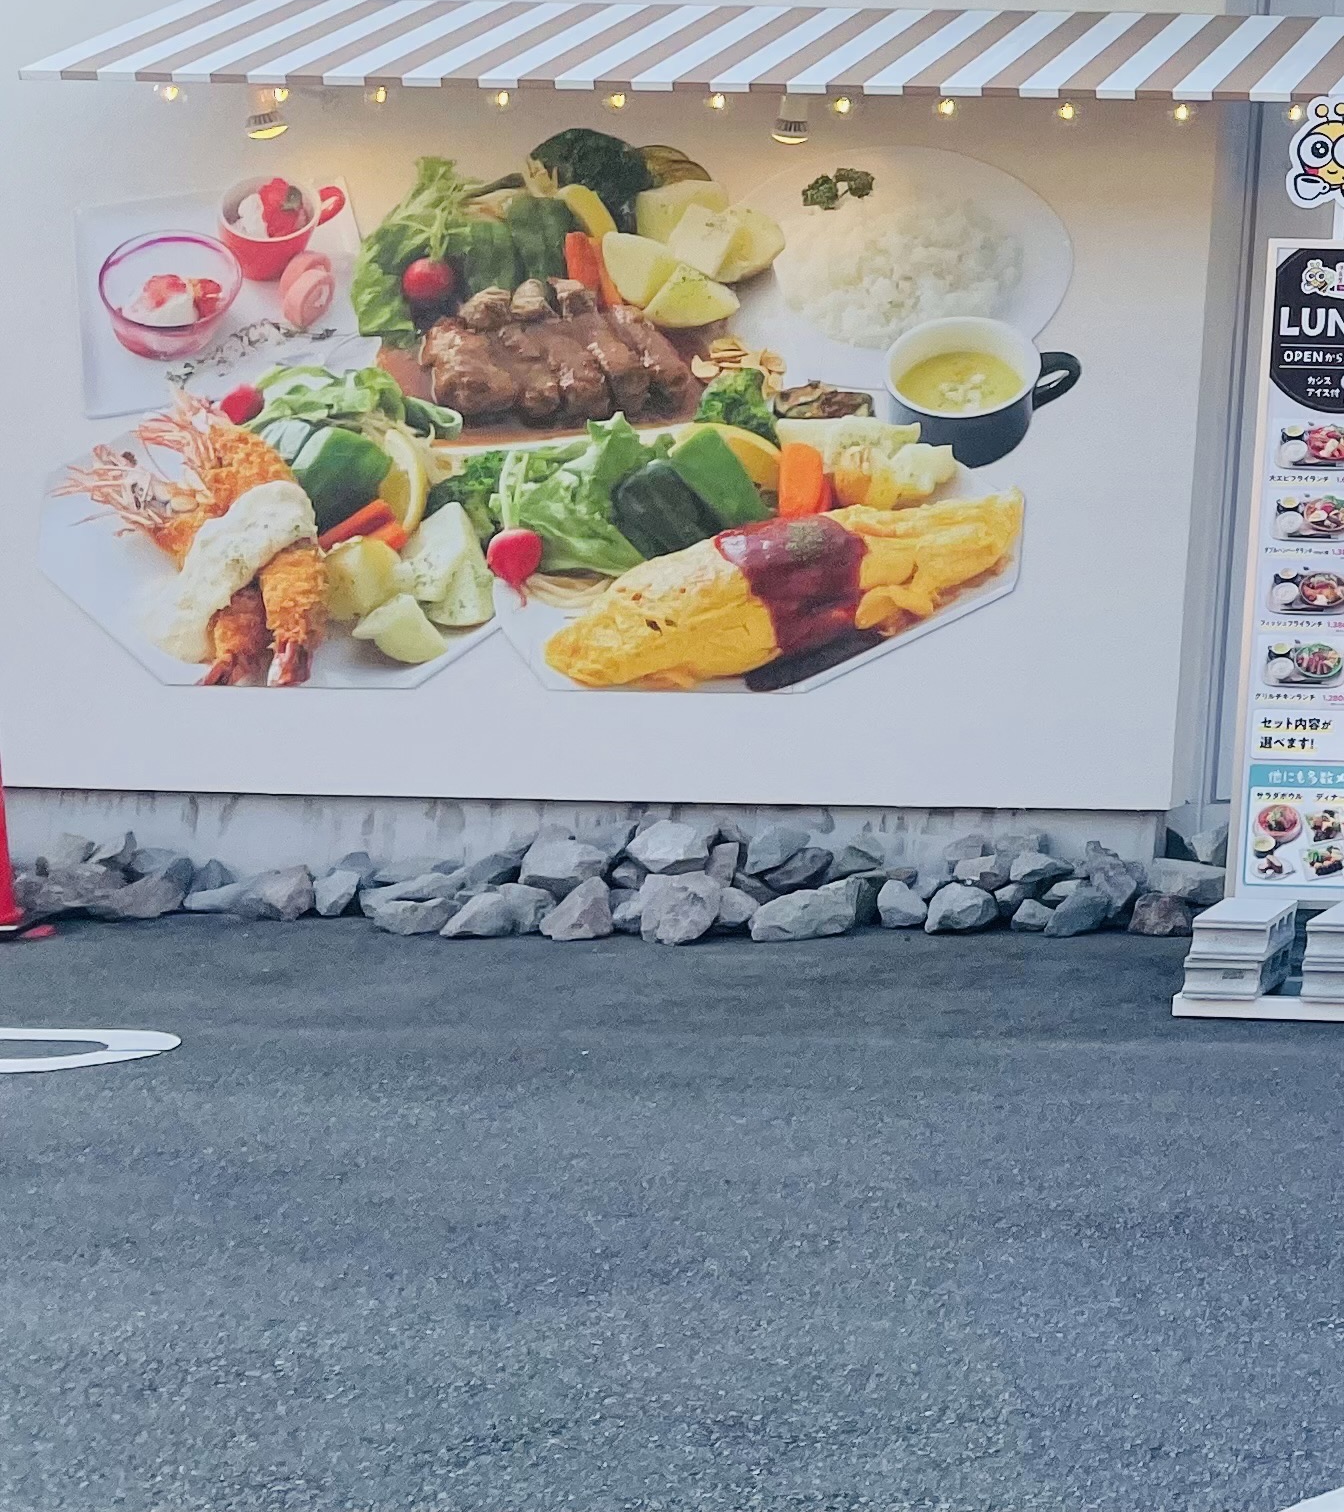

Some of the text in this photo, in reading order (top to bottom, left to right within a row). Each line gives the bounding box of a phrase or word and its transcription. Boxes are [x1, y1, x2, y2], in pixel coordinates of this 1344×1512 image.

[1261, 717, 1333, 731] セット内容が
[1259, 736, 1315, 750] 選べます!
